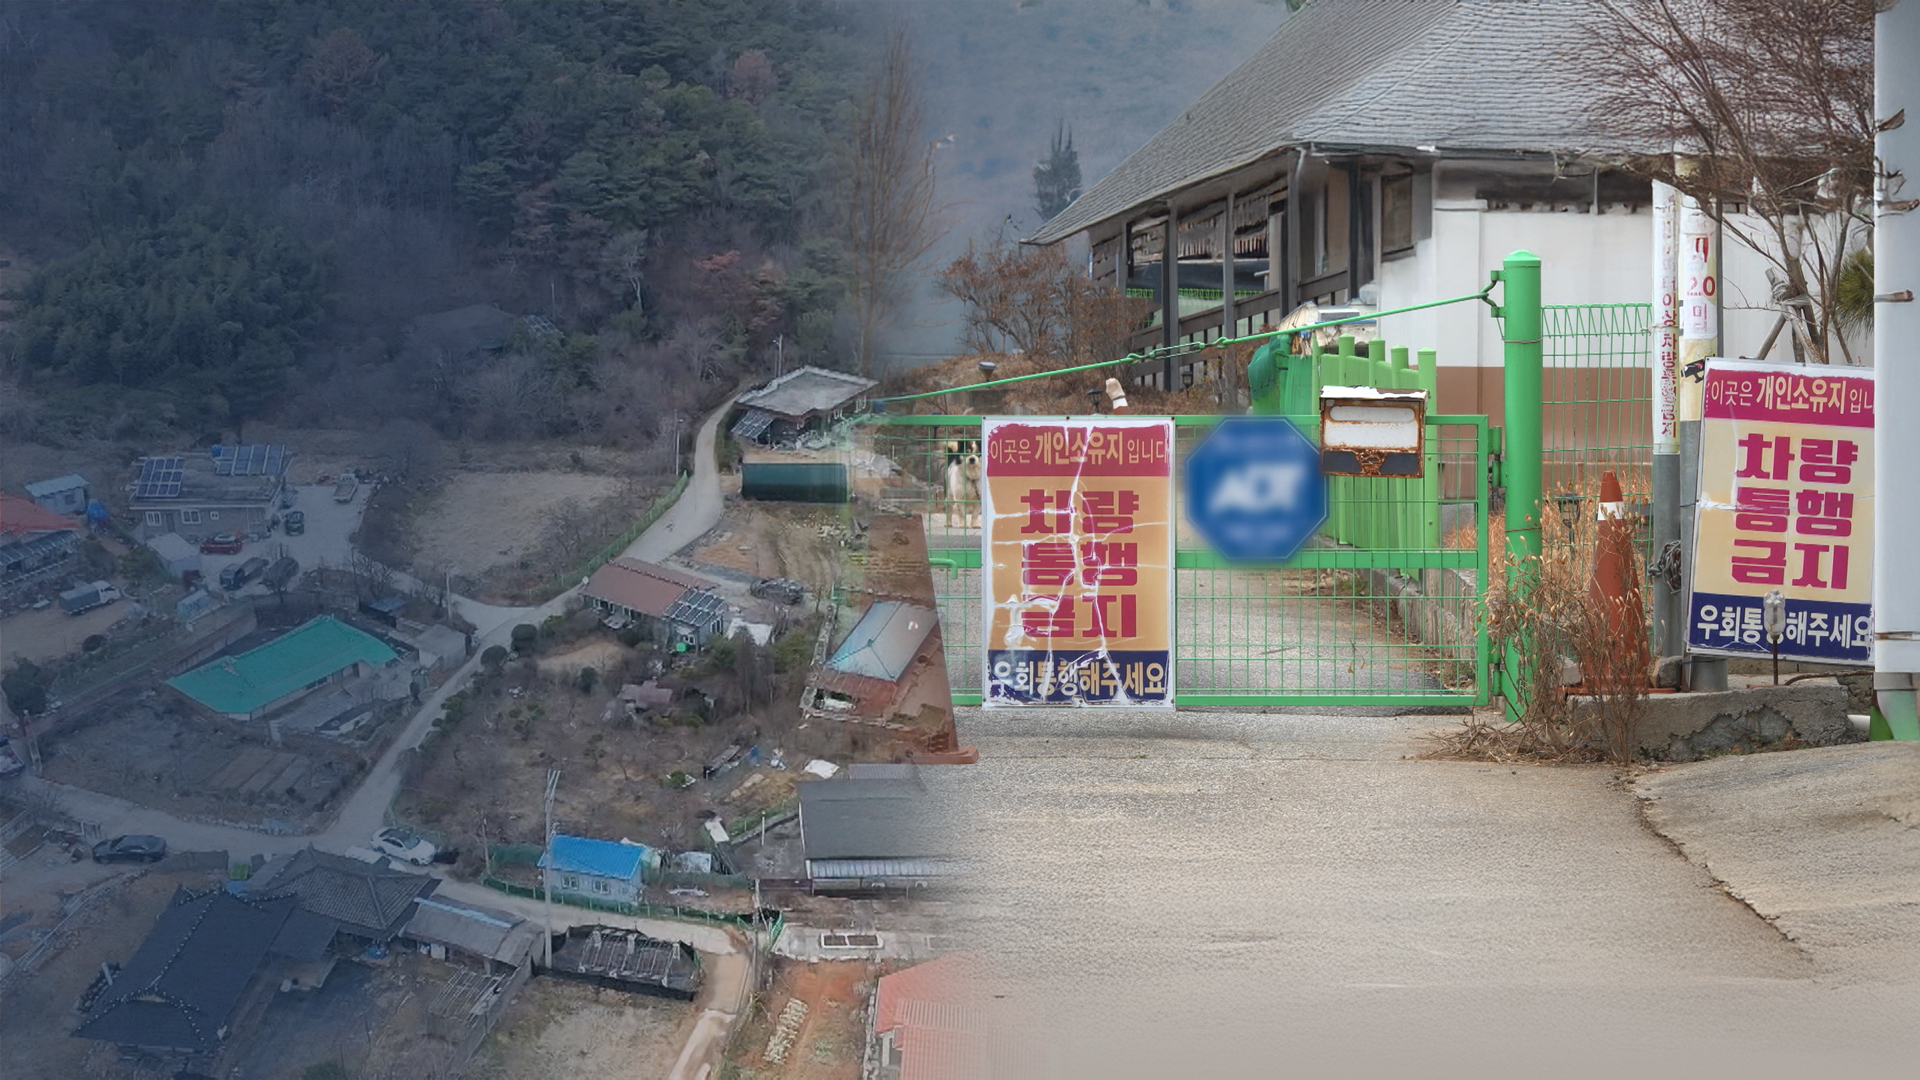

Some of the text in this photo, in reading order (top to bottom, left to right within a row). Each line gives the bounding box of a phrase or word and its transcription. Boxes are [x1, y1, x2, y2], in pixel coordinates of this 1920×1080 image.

[1711, 379, 1753, 407] 이곳은
[1756, 376, 1848, 414] 개인소유지
[990, 431, 1168, 465] 이곳은 개인소유지 입니다
[1737, 433, 1858, 484] 차량
[1020, 489, 1139, 534] 차량
[1735, 487, 1854, 537] 통행
[1021, 542, 1138, 586] 통행
[1731, 539, 1849, 590] 금지
[1021, 594, 1137, 638] 금지
[1697, 604, 1870, 650] 우회통해주세요
[991, 660, 1166, 697] 우회통행해주세요
